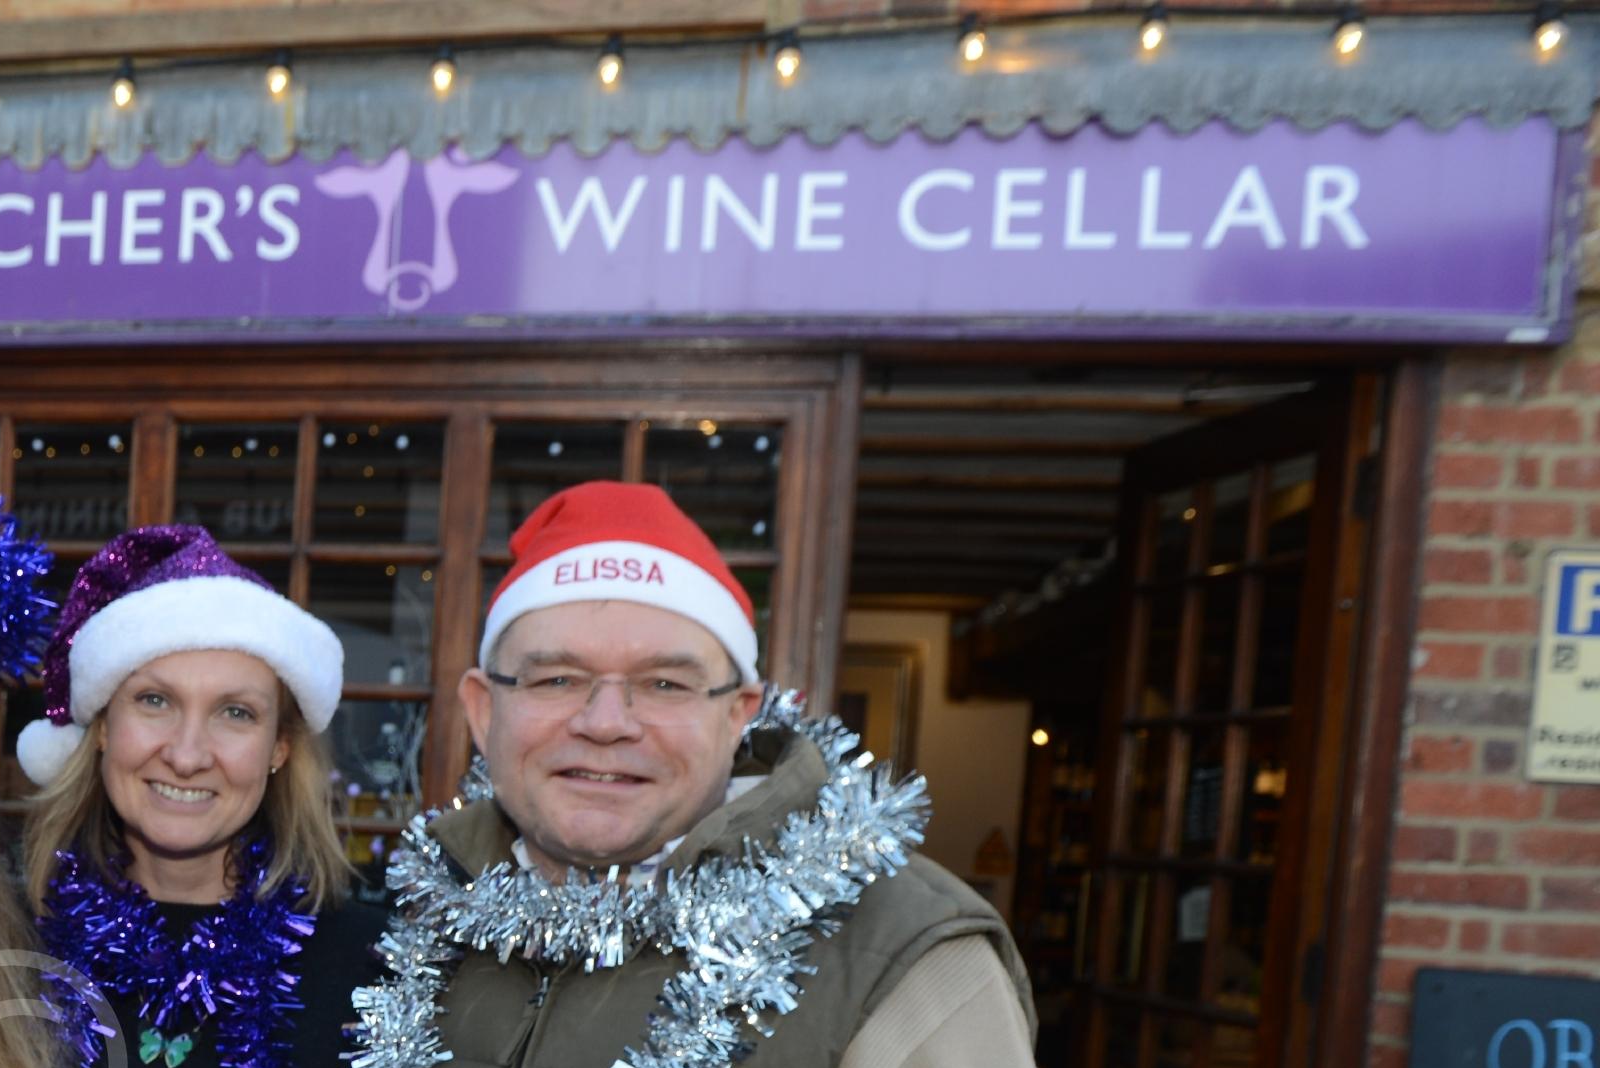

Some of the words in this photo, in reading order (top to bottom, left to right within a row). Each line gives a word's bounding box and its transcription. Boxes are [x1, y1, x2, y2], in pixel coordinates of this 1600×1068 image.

[536, 172, 848, 254] WINE
[897, 165, 1370, 251] CELLAR
[553, 557, 665, 586] ELISSA
